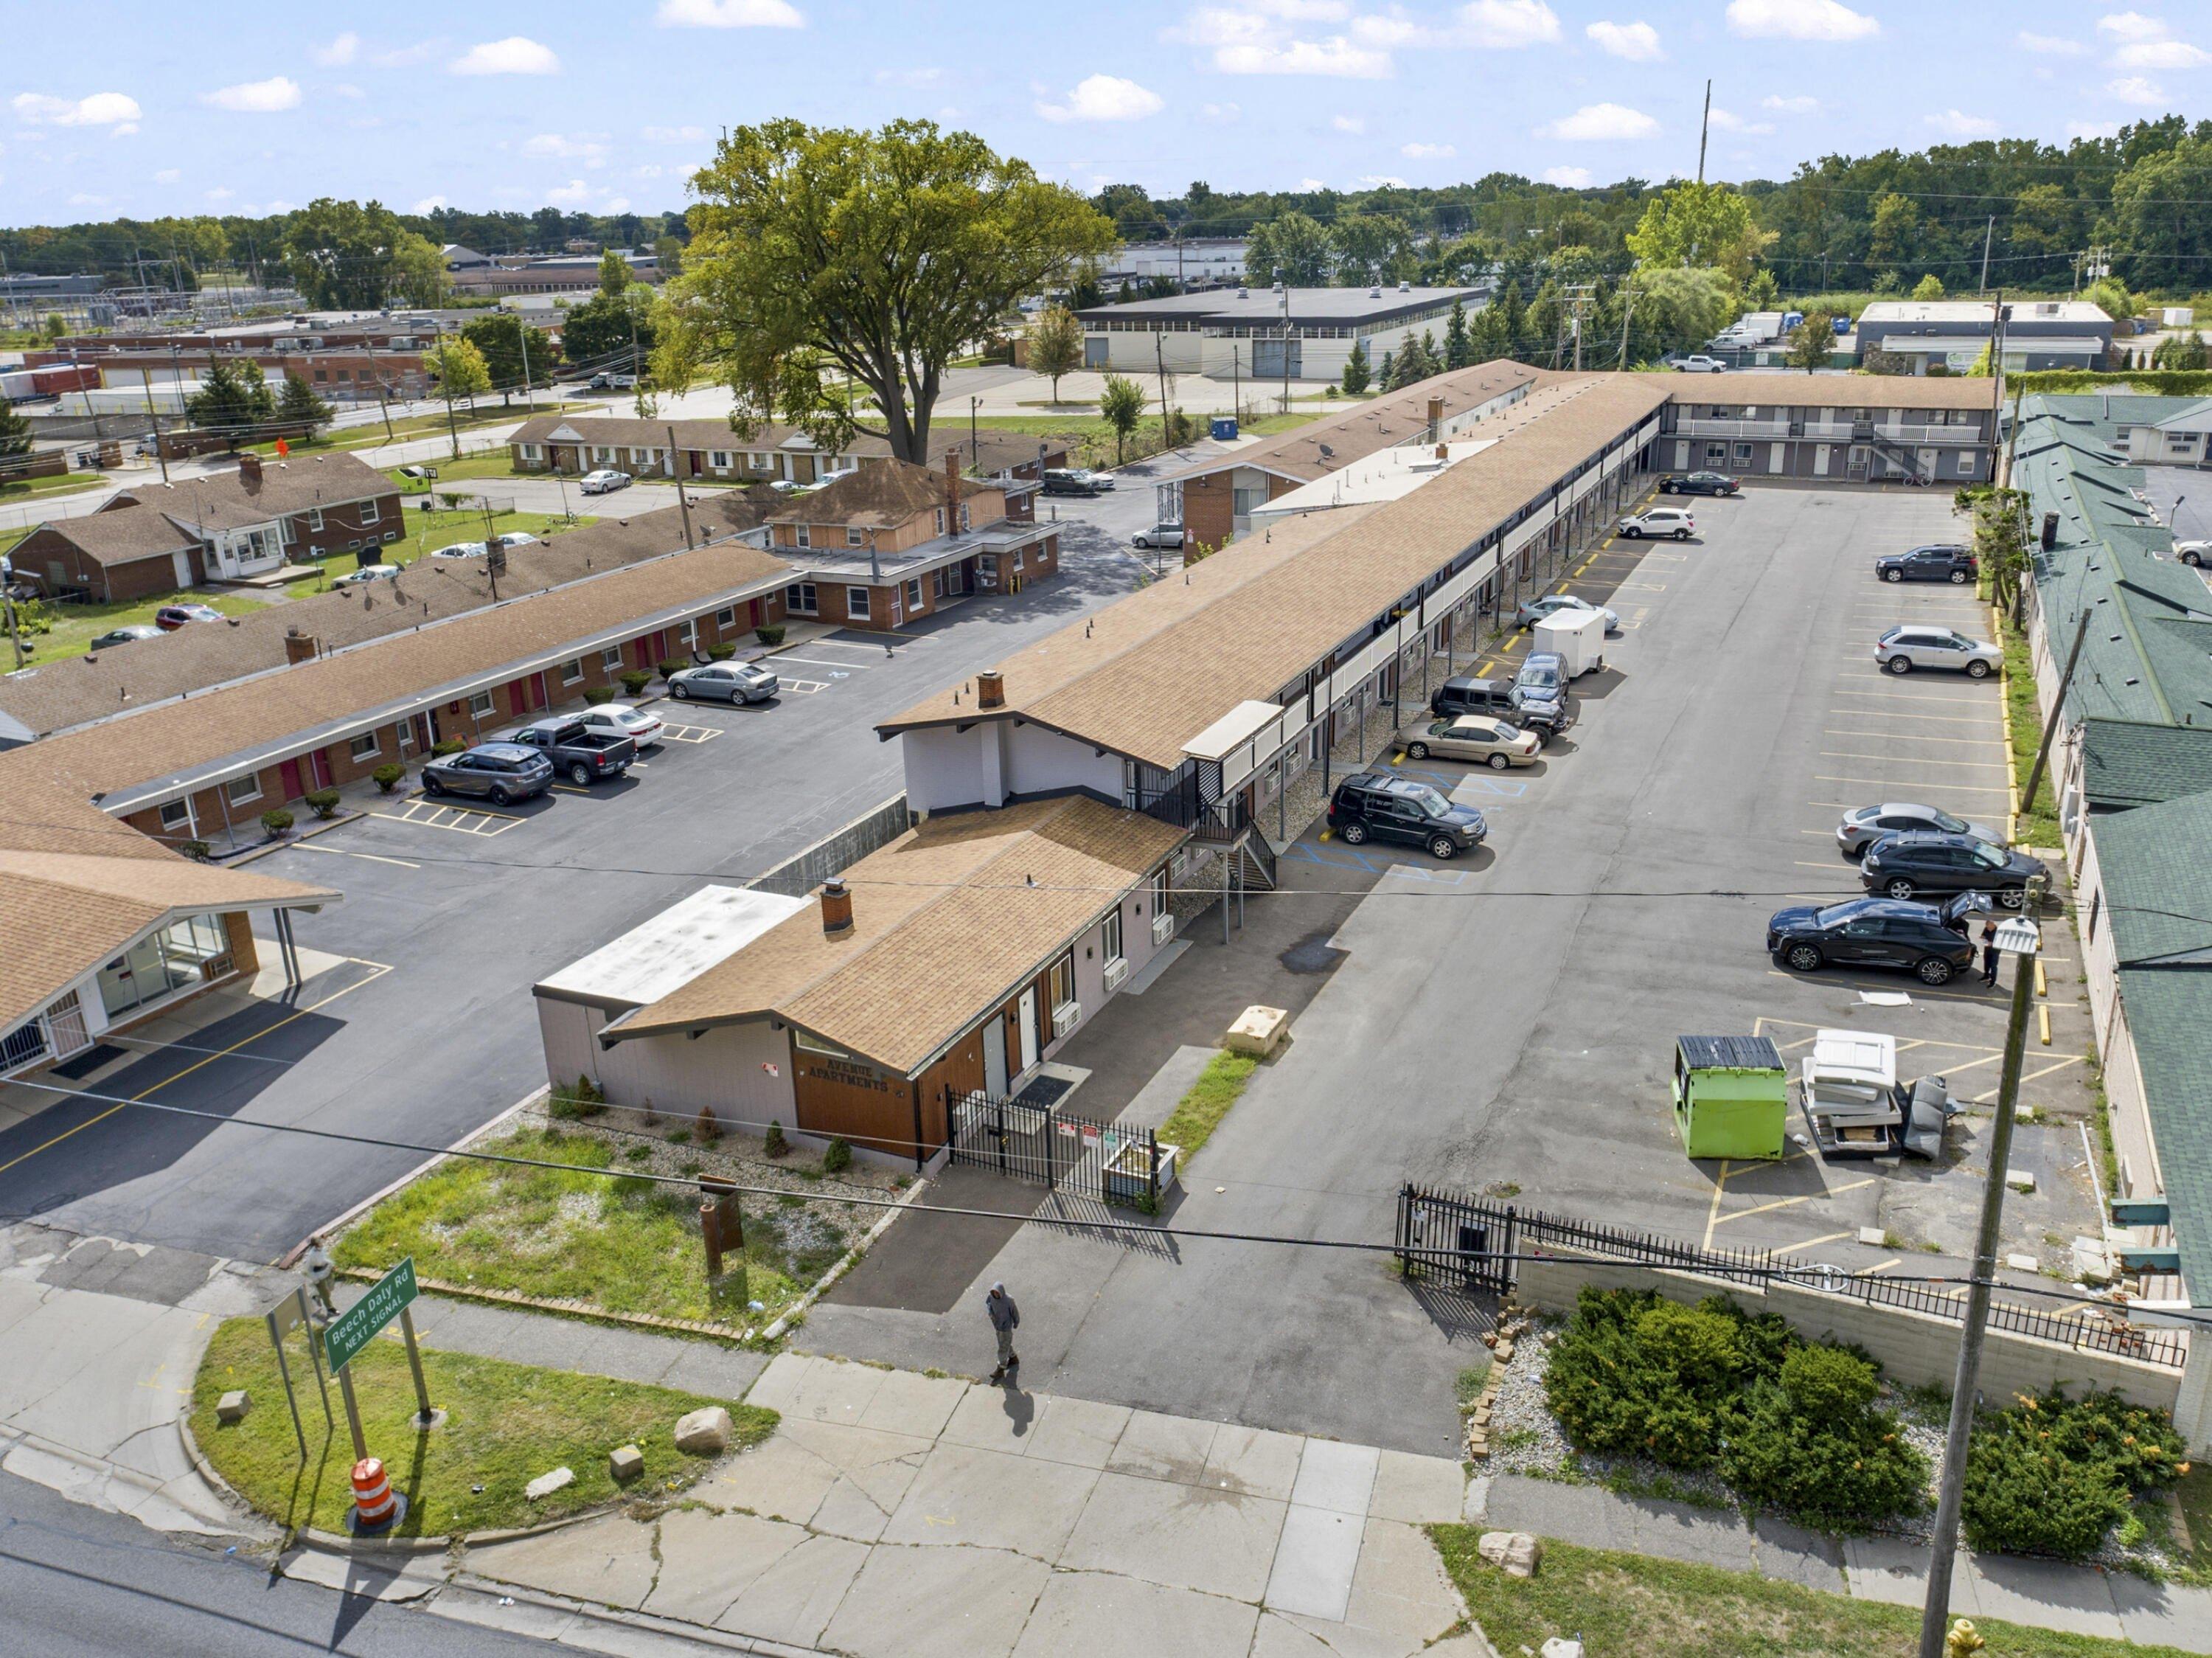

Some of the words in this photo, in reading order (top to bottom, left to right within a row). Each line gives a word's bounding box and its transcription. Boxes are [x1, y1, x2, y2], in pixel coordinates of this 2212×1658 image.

[810, 1067, 888, 1092] APARTMENTS
[827, 1059, 872, 1077] AVENUE
[332, 1308, 366, 1345] Beech
[368, 1284, 392, 1312] Daly
[394, 1268, 408, 1288] Rd
[344, 1325, 368, 1352] NEXT
[370, 1295, 403, 1328] SIGNAL
